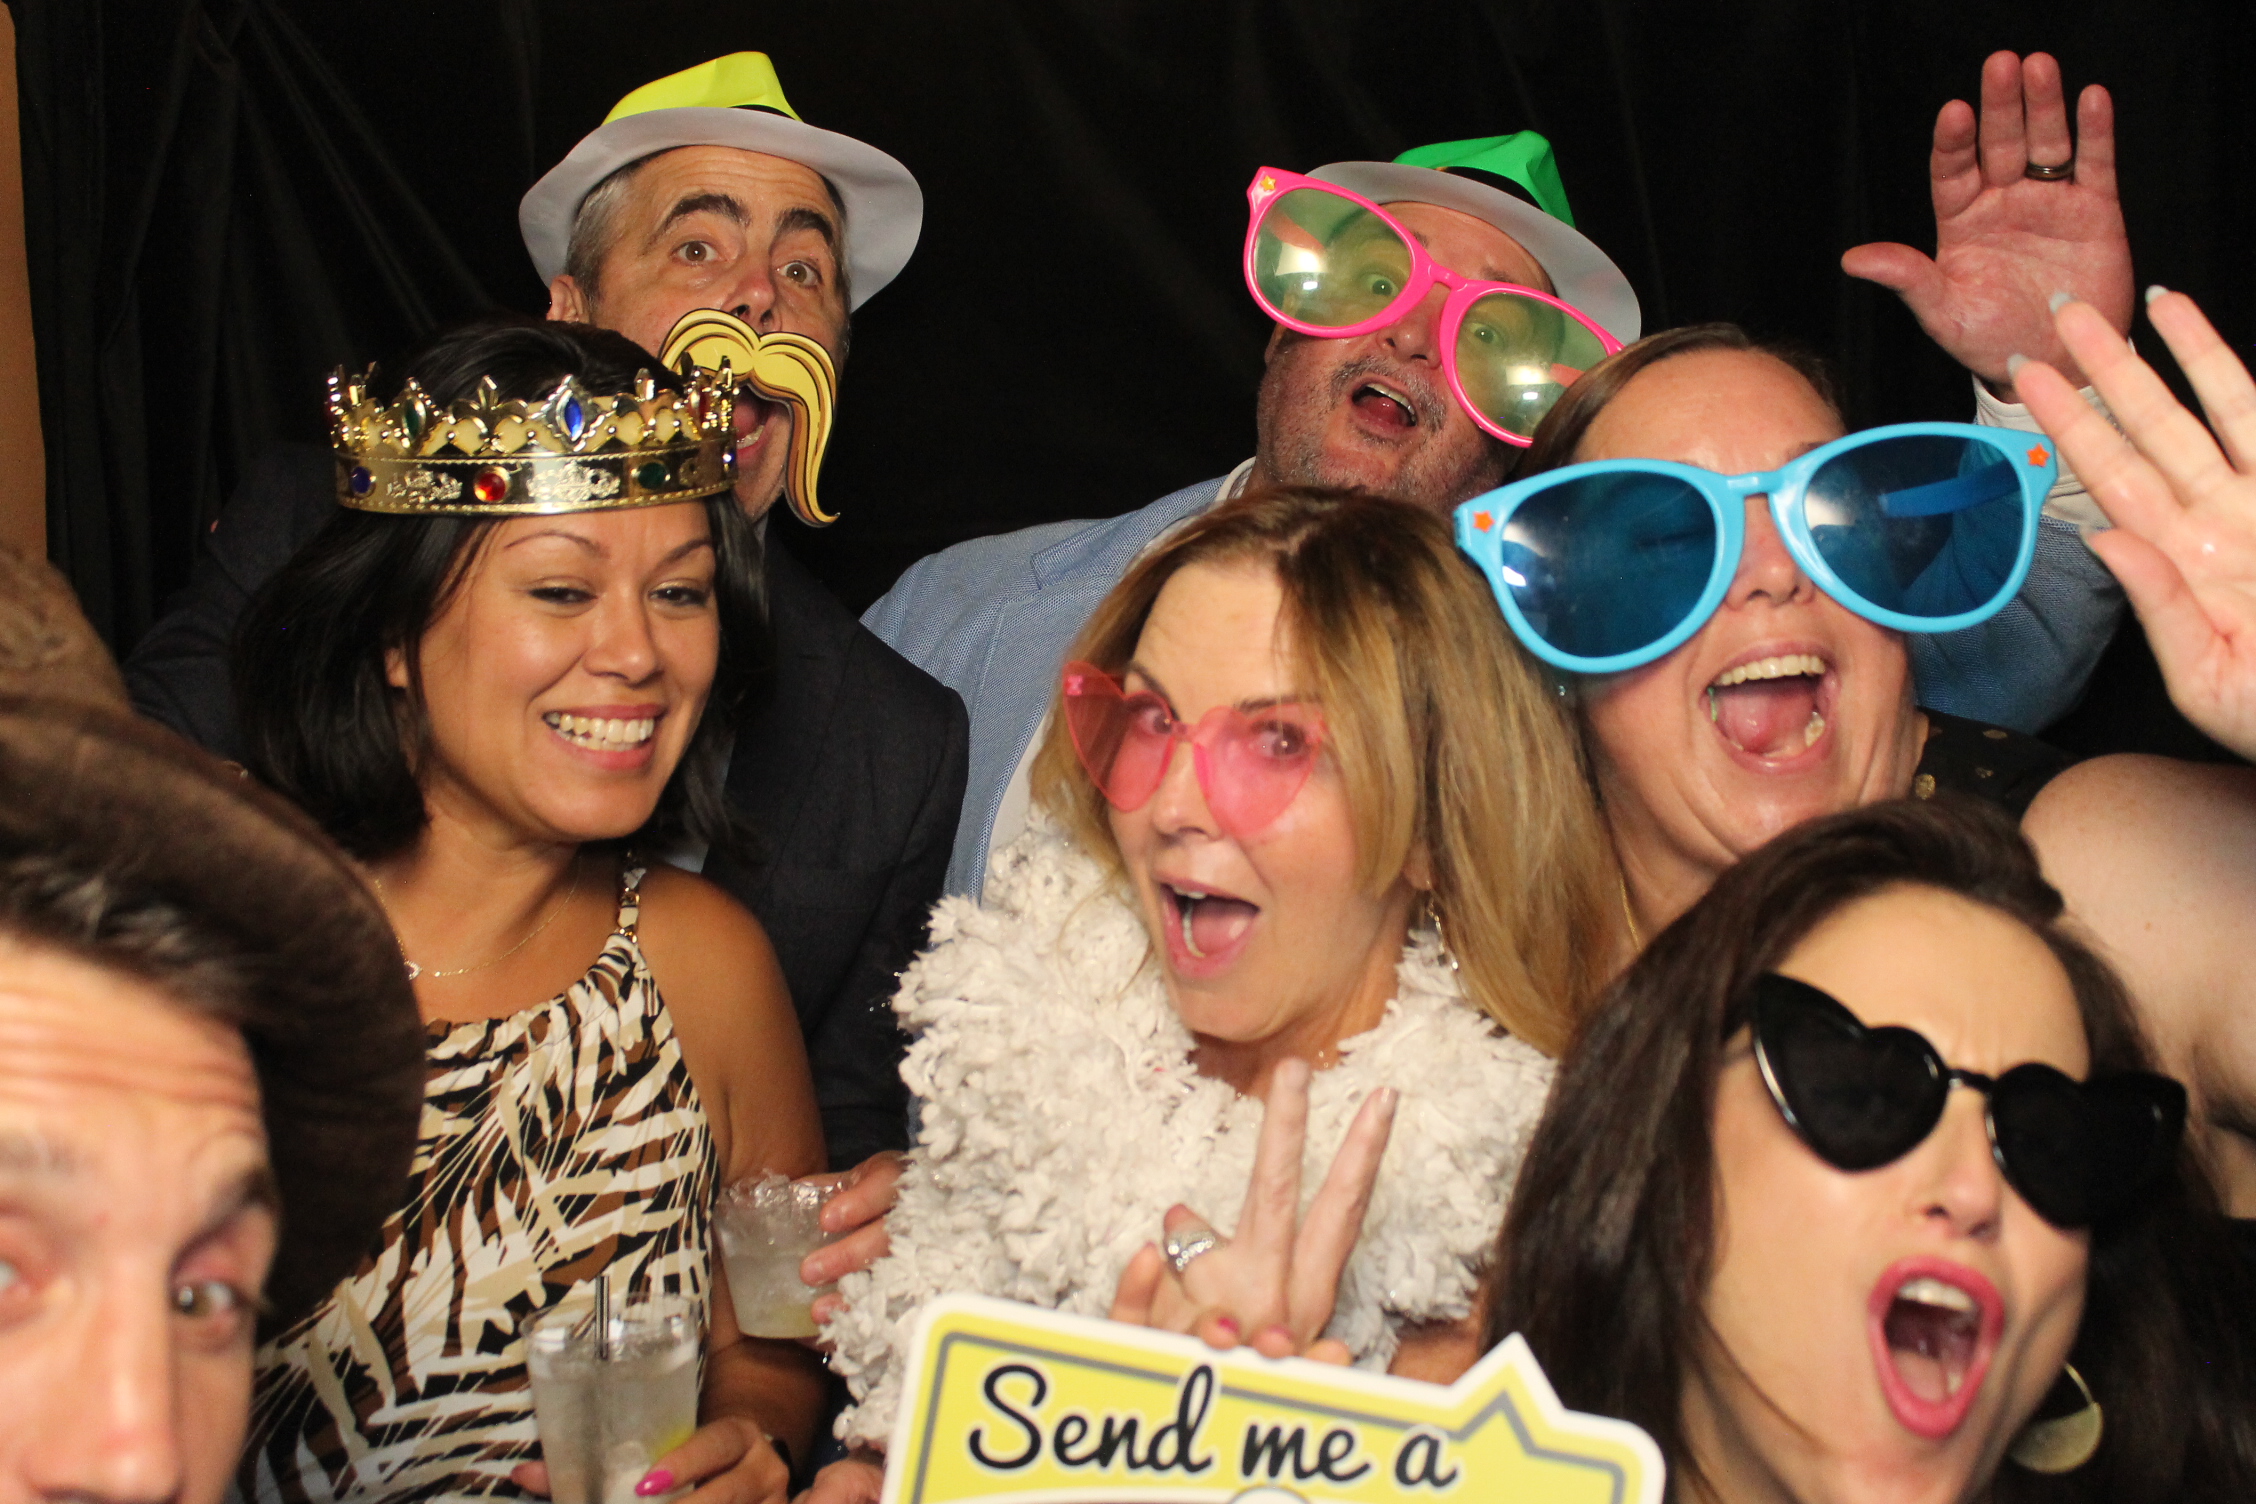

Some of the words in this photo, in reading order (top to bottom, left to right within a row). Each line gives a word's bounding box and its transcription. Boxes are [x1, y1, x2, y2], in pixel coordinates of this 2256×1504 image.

[968, 1364, 1214, 1474] Send
[1241, 1424, 1371, 1487] me
[1394, 1433, 1458, 1489] a
